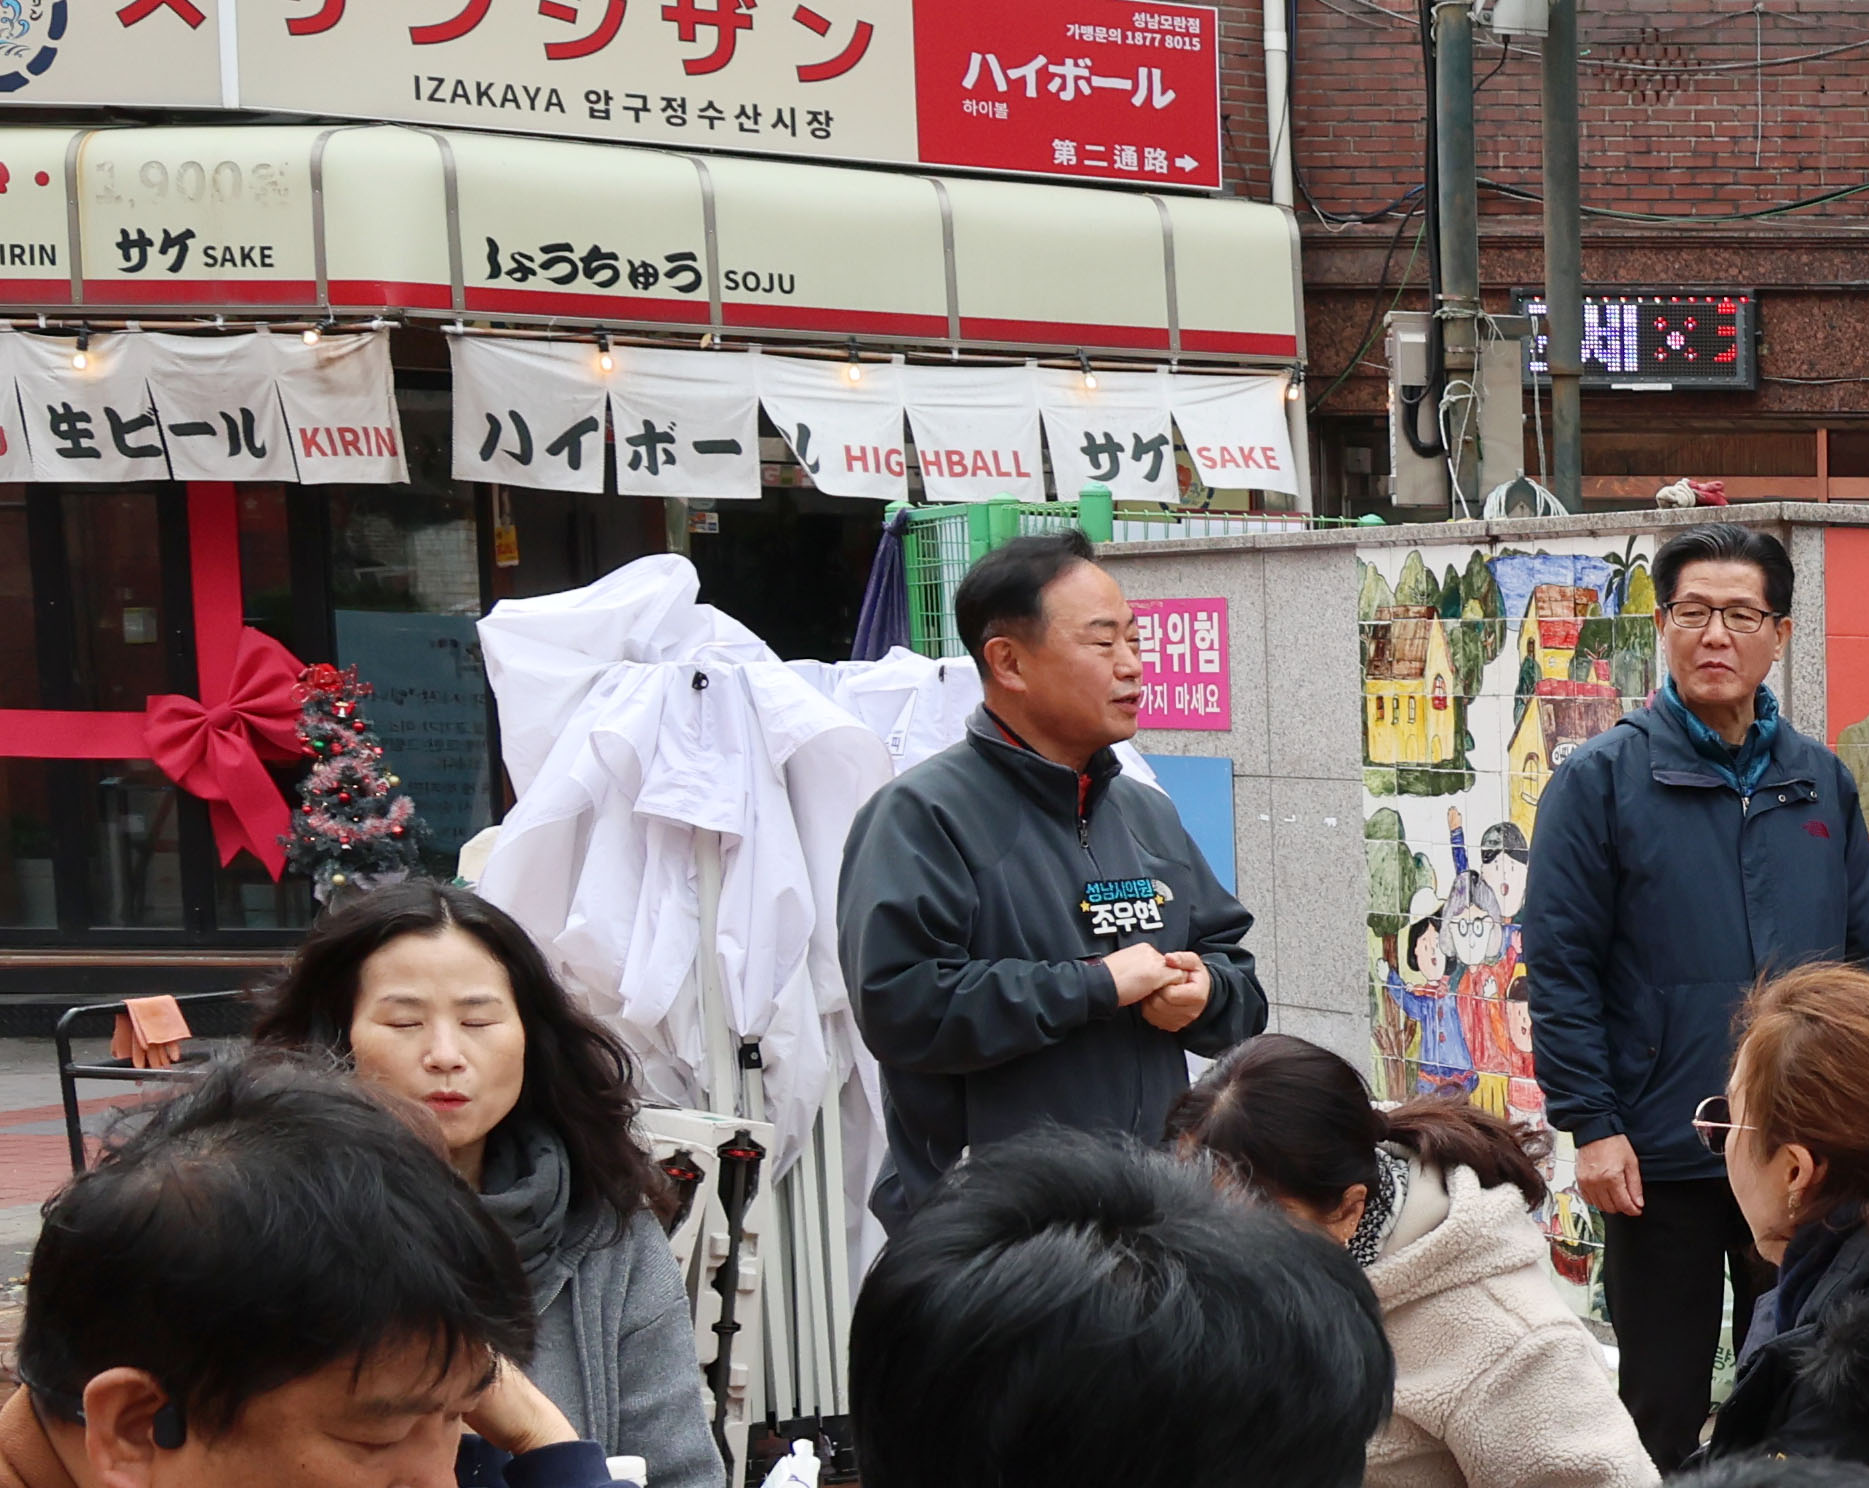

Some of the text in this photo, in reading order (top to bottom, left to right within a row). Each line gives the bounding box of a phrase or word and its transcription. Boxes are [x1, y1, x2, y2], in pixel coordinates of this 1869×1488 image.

[1066, 24, 1201, 51] 가맹문의 1877 8015
[1132, 12, 1201, 34] 성남모란점
[961, 52, 1176, 109] ハイボール
[414, 75, 835, 140] IZAKAYA 압구정수산시장
[962, 99, 1009, 119] 하이볼
[1051, 138, 1169, 174] 第二通路
[115, 228, 275, 273] サケ SAKE
[486, 236, 796, 294] しょうちゅう SOJU
[47, 402, 267, 459] 生ビール
[301, 426, 399, 459] KIRIN
[844, 444, 1032, 479] HIGHBALL
[1197, 445, 1281, 472] SAKE
[1136, 611, 1221, 673] 락위험
[1175, 682, 1221, 716] 마세요
[1086, 879, 1154, 903] 성남시의원
[1090, 898, 1164, 935] 조우현
